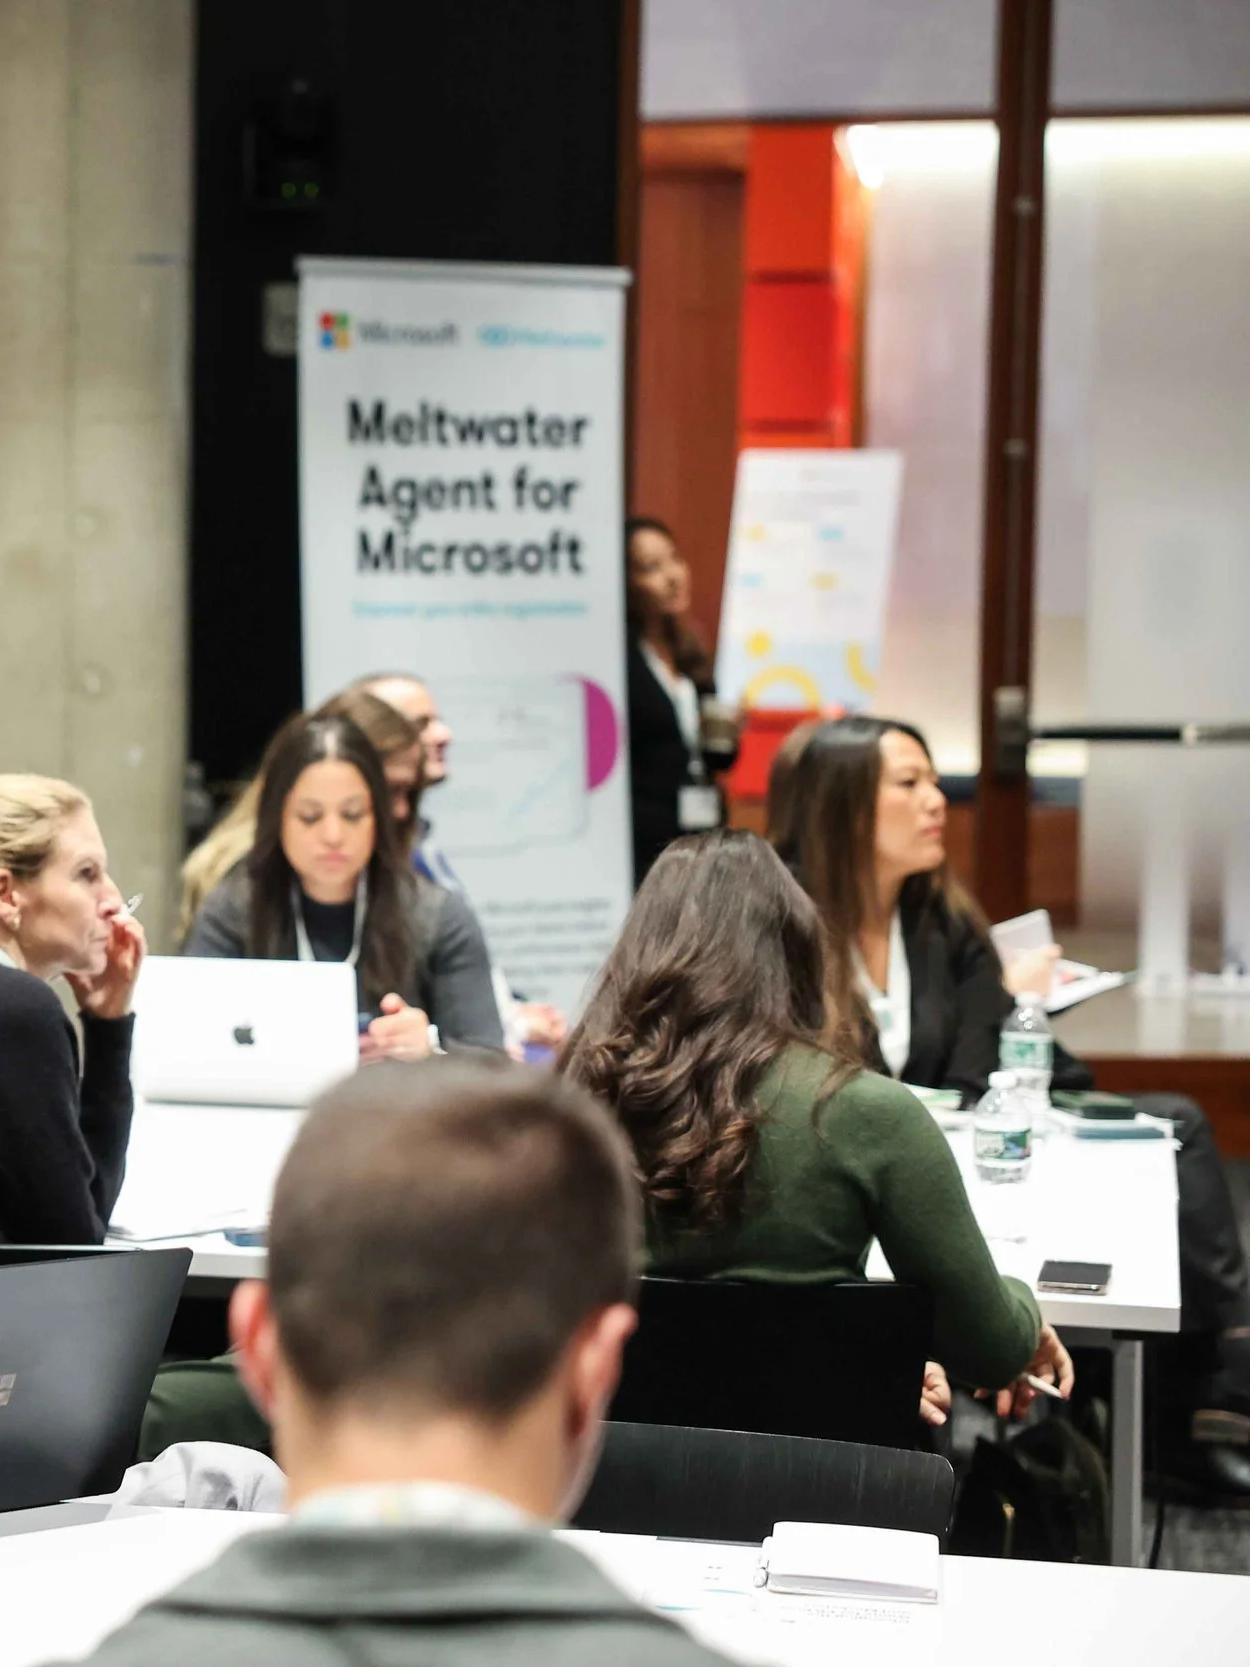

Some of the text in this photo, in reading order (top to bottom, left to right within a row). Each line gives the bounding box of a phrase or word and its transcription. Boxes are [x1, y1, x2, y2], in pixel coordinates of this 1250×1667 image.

[349, 399, 587, 446] Meltwater
[359, 466, 579, 526] Agent for
[358, 529, 583, 574] Microsoft
